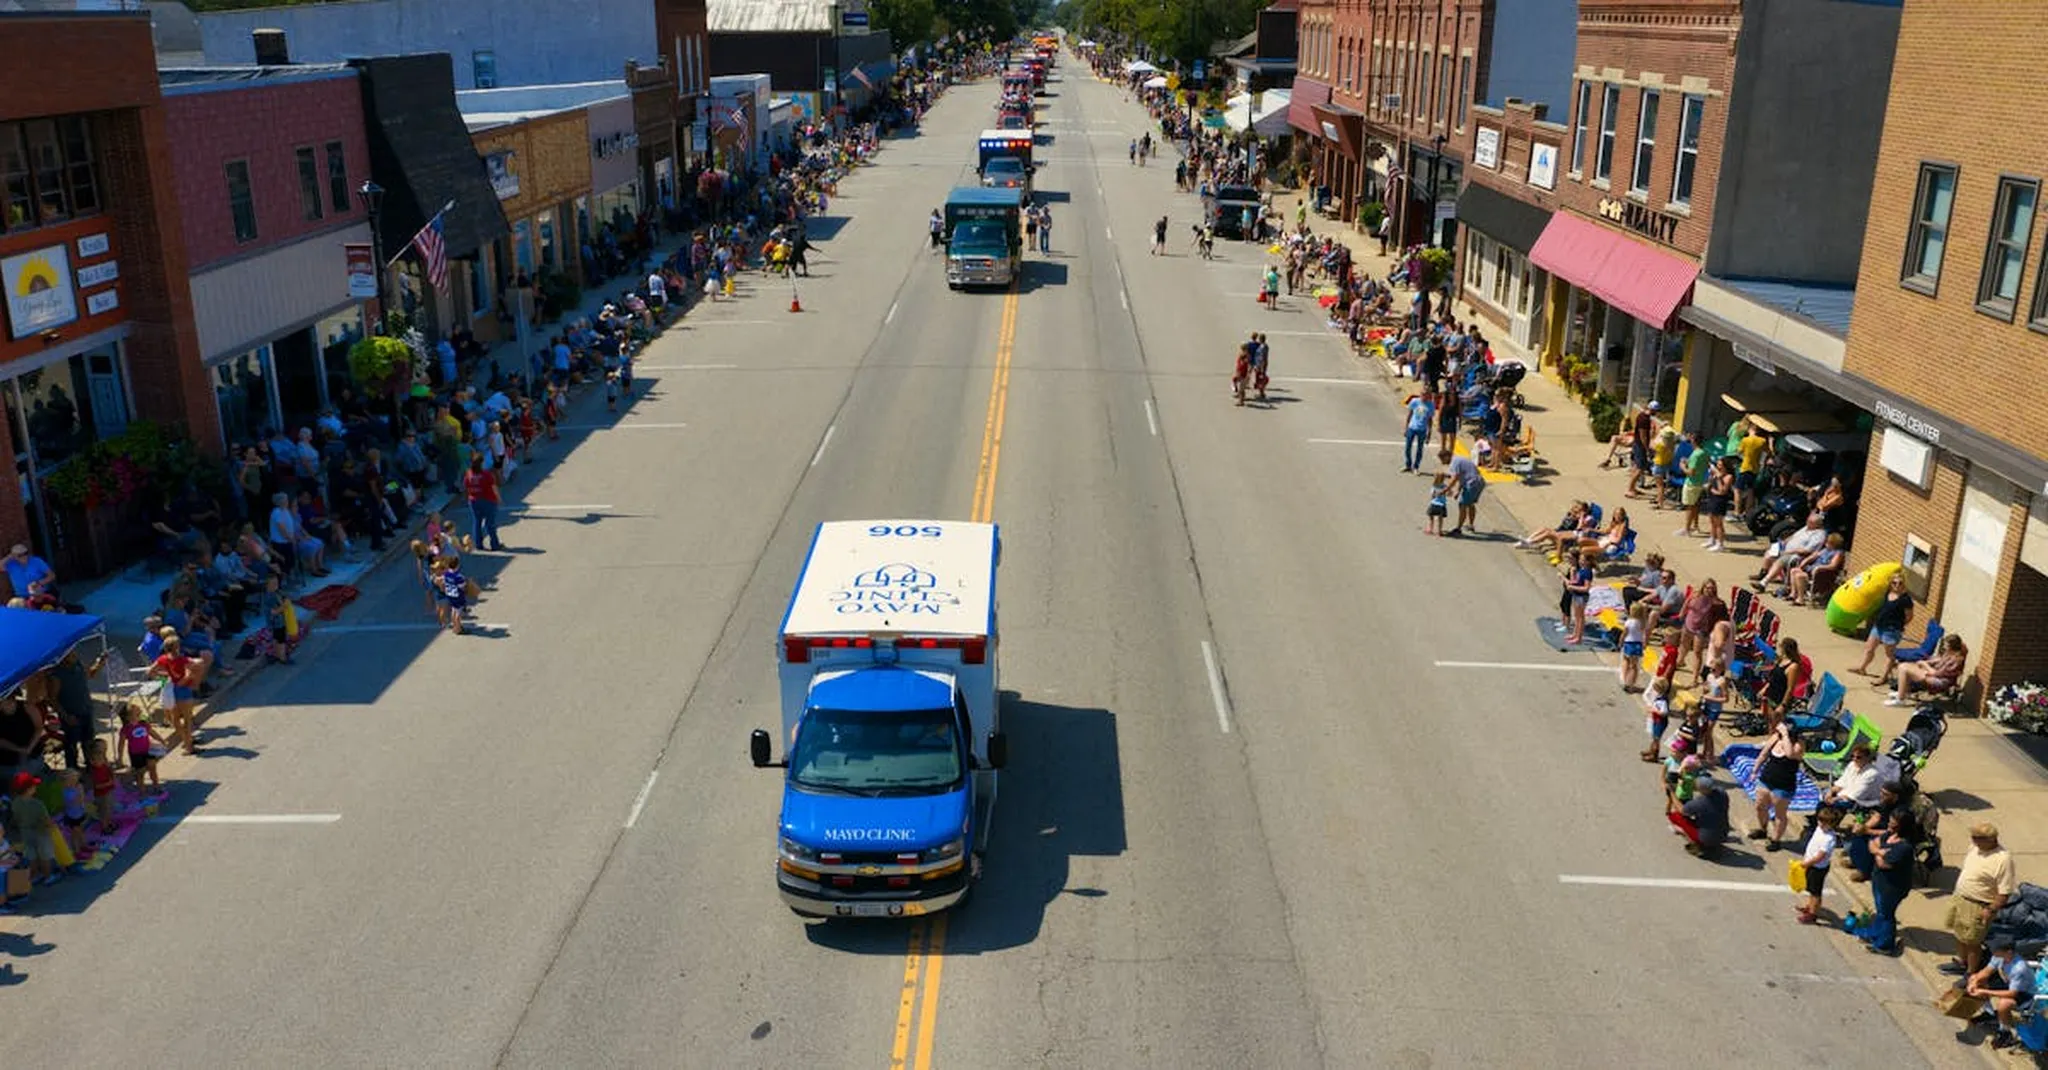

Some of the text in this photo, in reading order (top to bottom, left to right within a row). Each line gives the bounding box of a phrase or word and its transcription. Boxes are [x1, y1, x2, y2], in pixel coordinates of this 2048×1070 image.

[1624, 202, 1678, 244] REALTY
[1875, 401, 1940, 443] FITNESS CENTER
[869, 526, 942, 536] 506
[829, 591, 954, 602] CLINIC
[837, 602, 940, 613] MAYO
[824, 828, 916, 841] MAYO CLINIC
